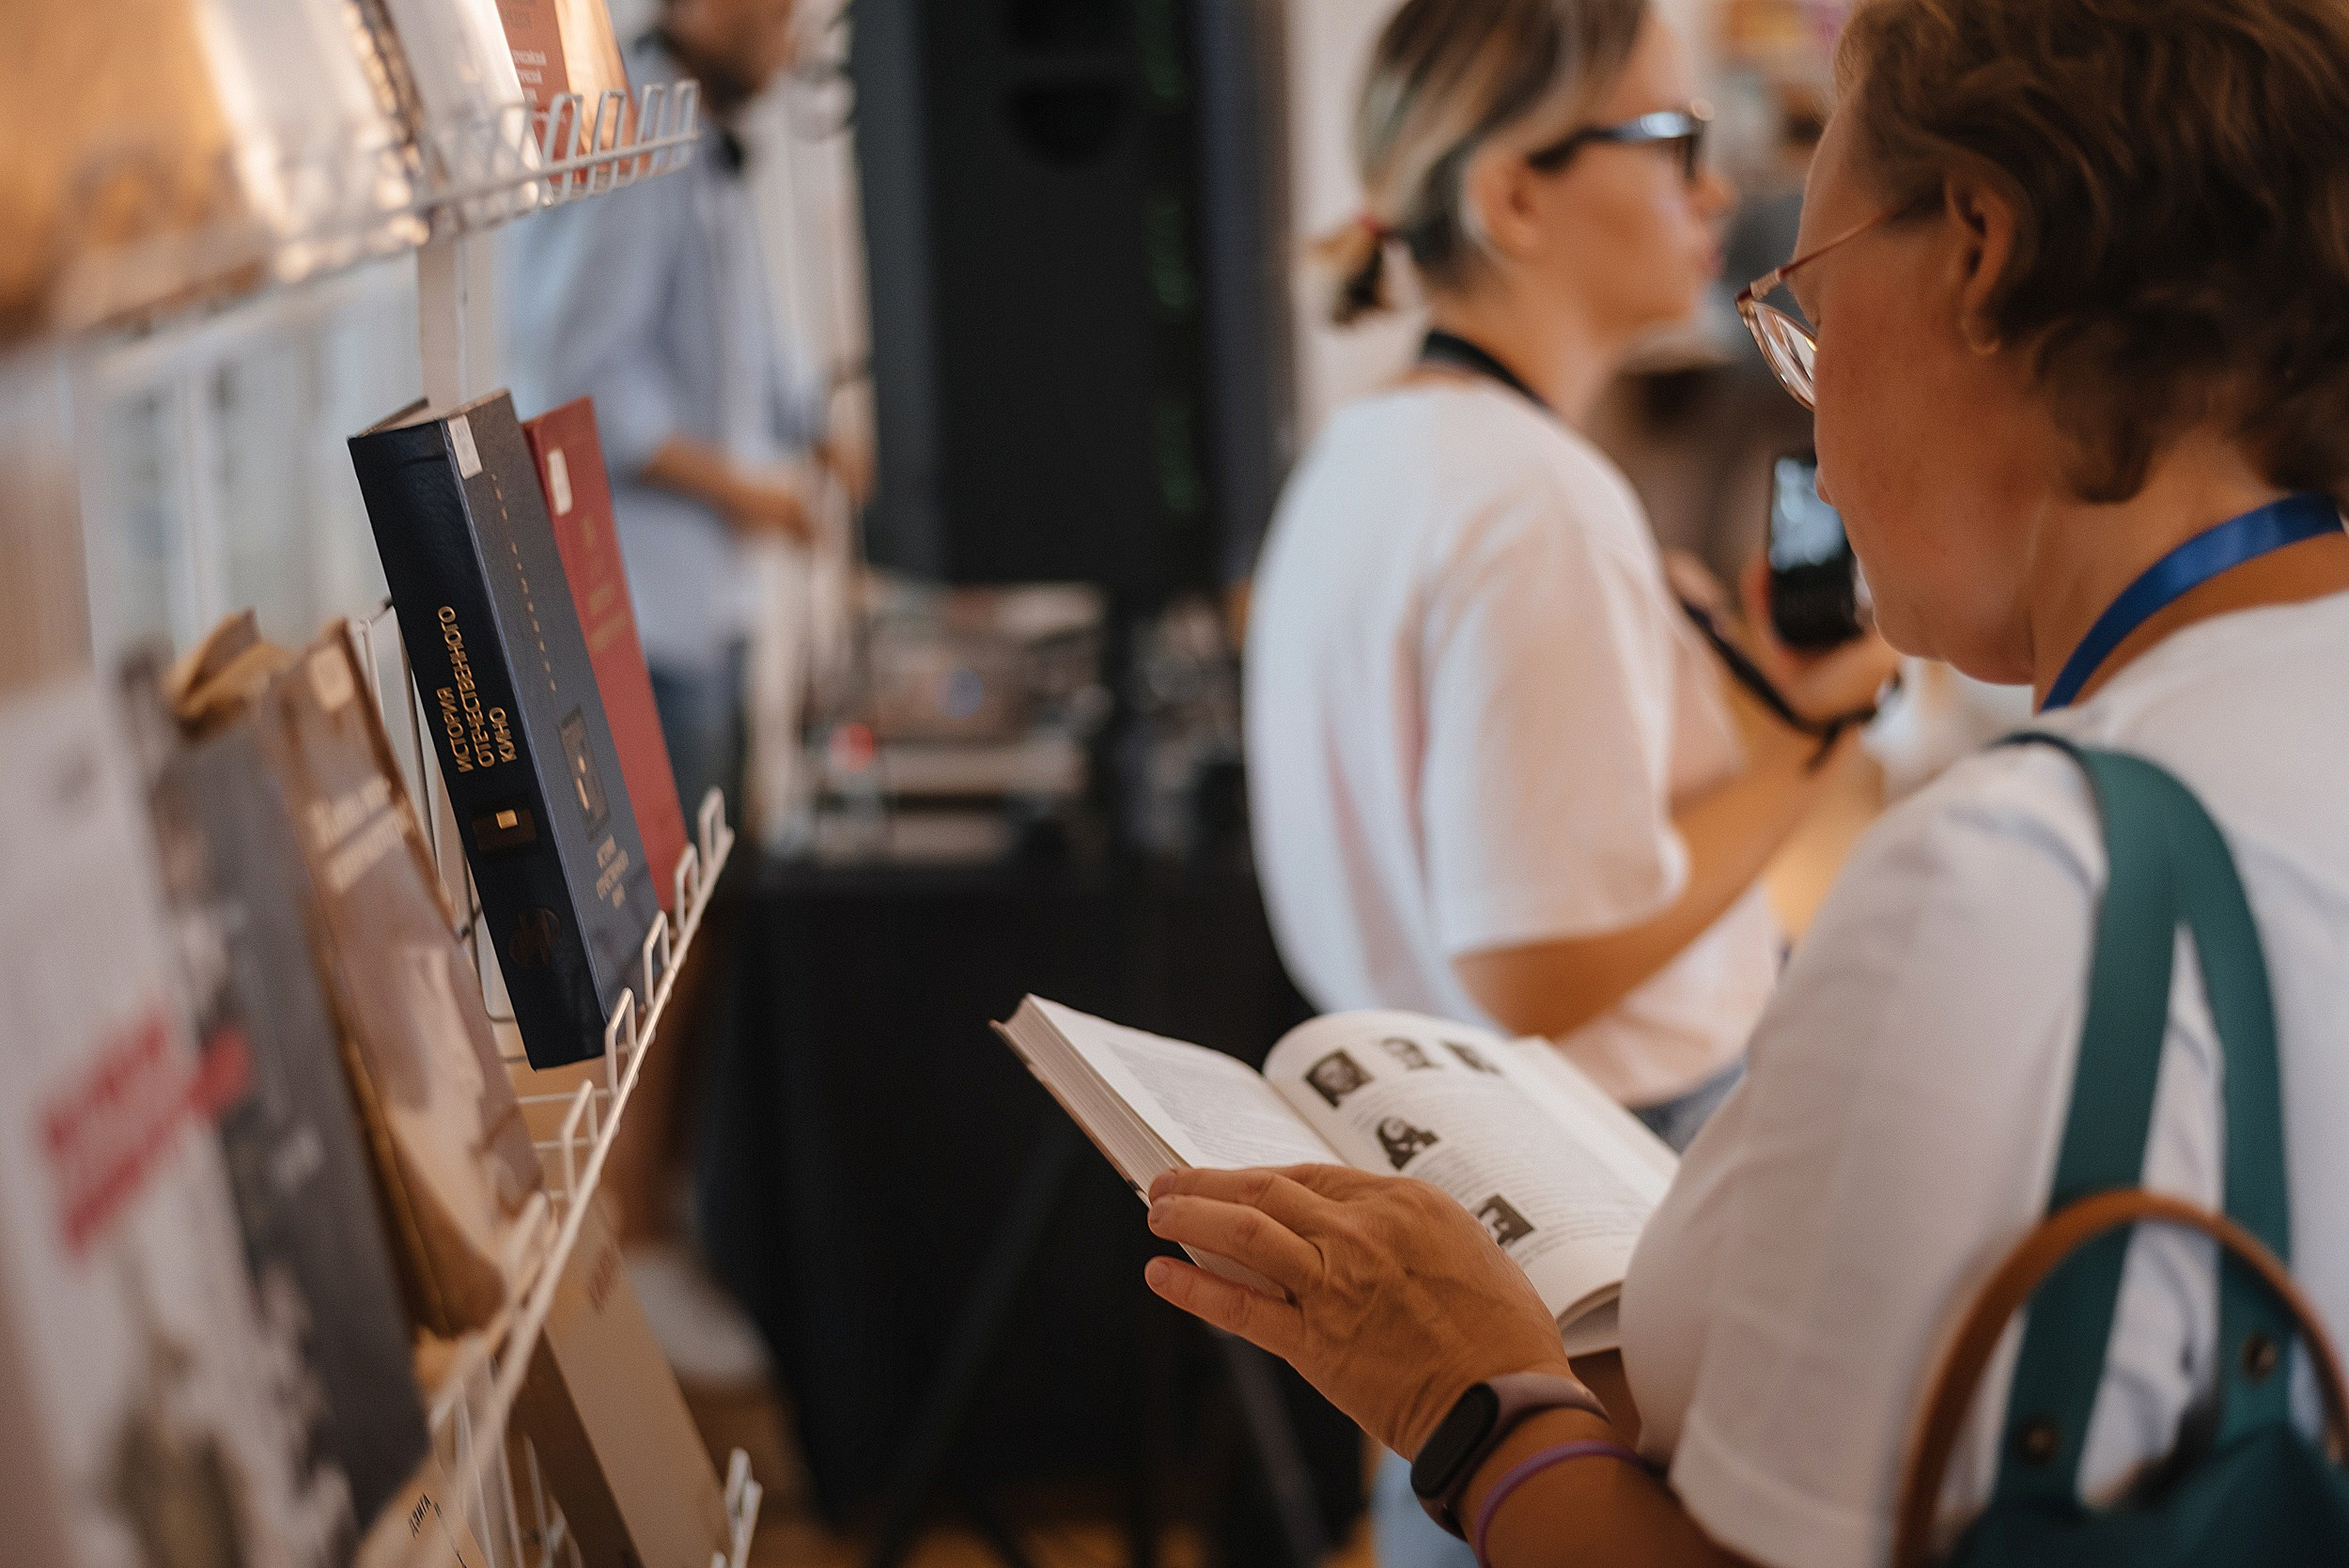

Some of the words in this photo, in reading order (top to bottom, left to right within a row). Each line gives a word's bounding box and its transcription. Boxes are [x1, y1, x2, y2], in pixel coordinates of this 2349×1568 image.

[437, 687, 474, 772] ИСТОРИЯ
[438, 606, 494, 768] ОТЕЧЕСТВЕННОГО
[489, 706, 517, 763] КИНО
